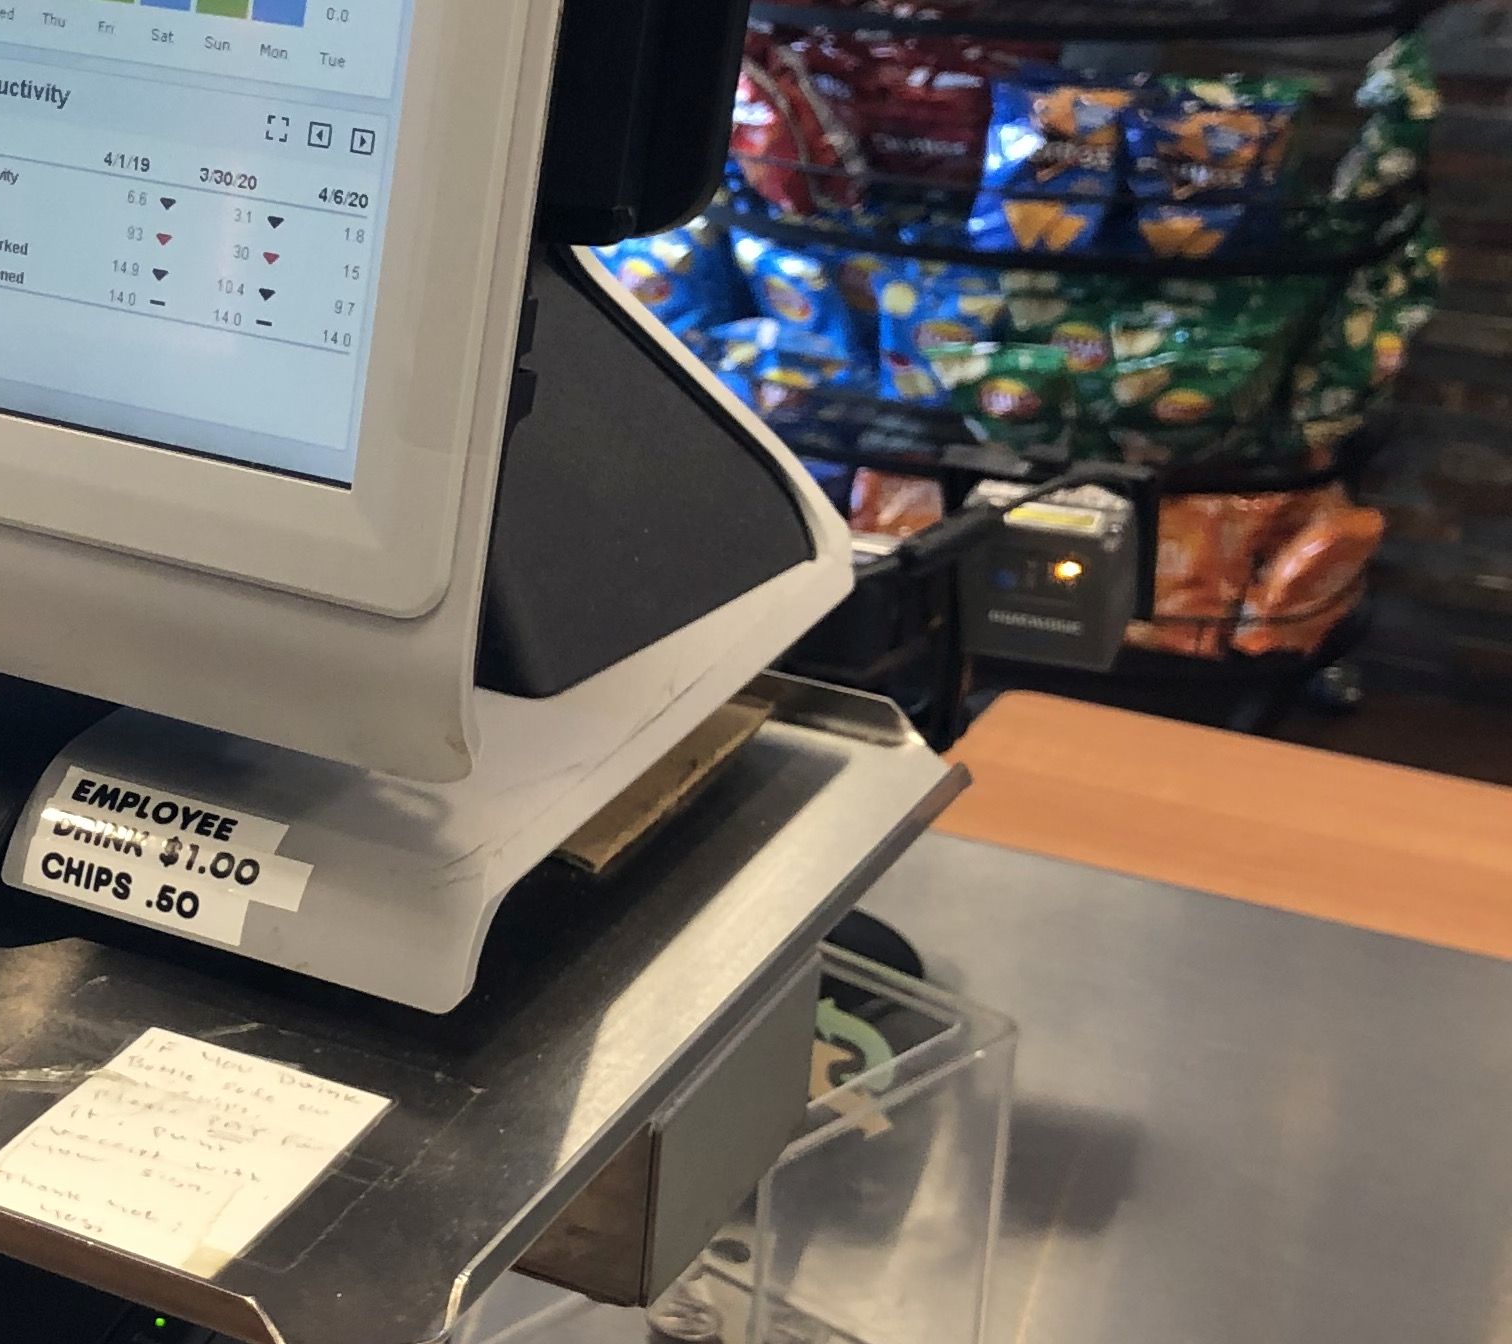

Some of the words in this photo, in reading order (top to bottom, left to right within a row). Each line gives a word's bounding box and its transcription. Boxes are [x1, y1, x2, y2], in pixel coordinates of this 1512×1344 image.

[41, 11, 66, 28] Thu
[97, 20, 115, 36] Fri
[151, 27, 175, 44] Sat
[204, 35, 231, 52] Sun
[259, 43, 289, 61] Mon
[319, 52, 347, 69] Tue
[103, 151, 150, 173] 4/1/19
[199, 166, 258, 191] 3/30/20
[318, 186, 369, 210] 4/6/20
[232, 244, 250, 261] 30
[343, 263, 360, 280] 15
[72, 778, 238, 843] EMPLOYEE
[158, 835, 260, 886] $1.00
[41, 851, 133, 901] CHIPS
[144, 884, 200, 920] .50
